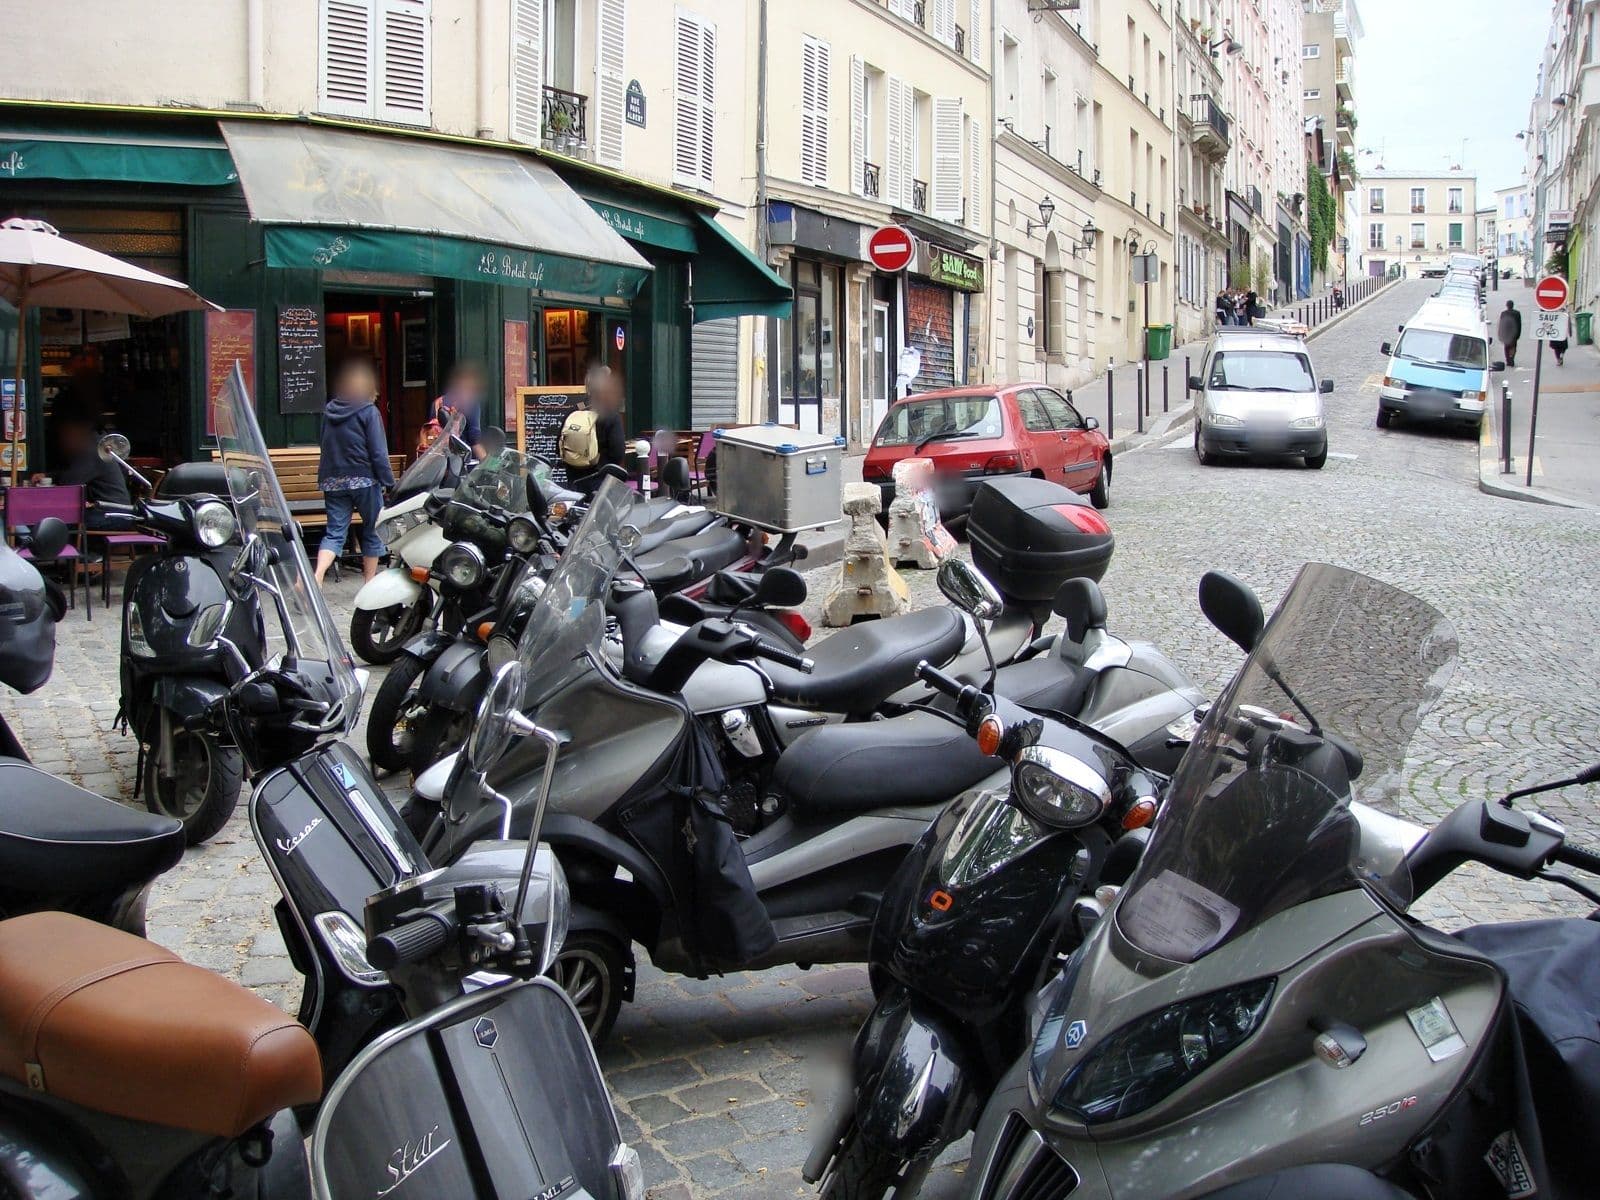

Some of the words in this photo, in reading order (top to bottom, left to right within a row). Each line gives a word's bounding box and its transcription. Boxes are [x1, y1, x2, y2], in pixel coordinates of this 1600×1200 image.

[630, 103, 641, 114] PAUL
[631, 96, 640, 106] RUE
[627, 111, 643, 123] ALBERT
[0, 151, 26, 176] afé
[483, 252, 498, 274] Le
[529, 262, 545, 288] café
[1538, 313, 1559, 322] SAUF
[276, 817, 323, 856] Vespa
[380, 1125, 450, 1194] Star
